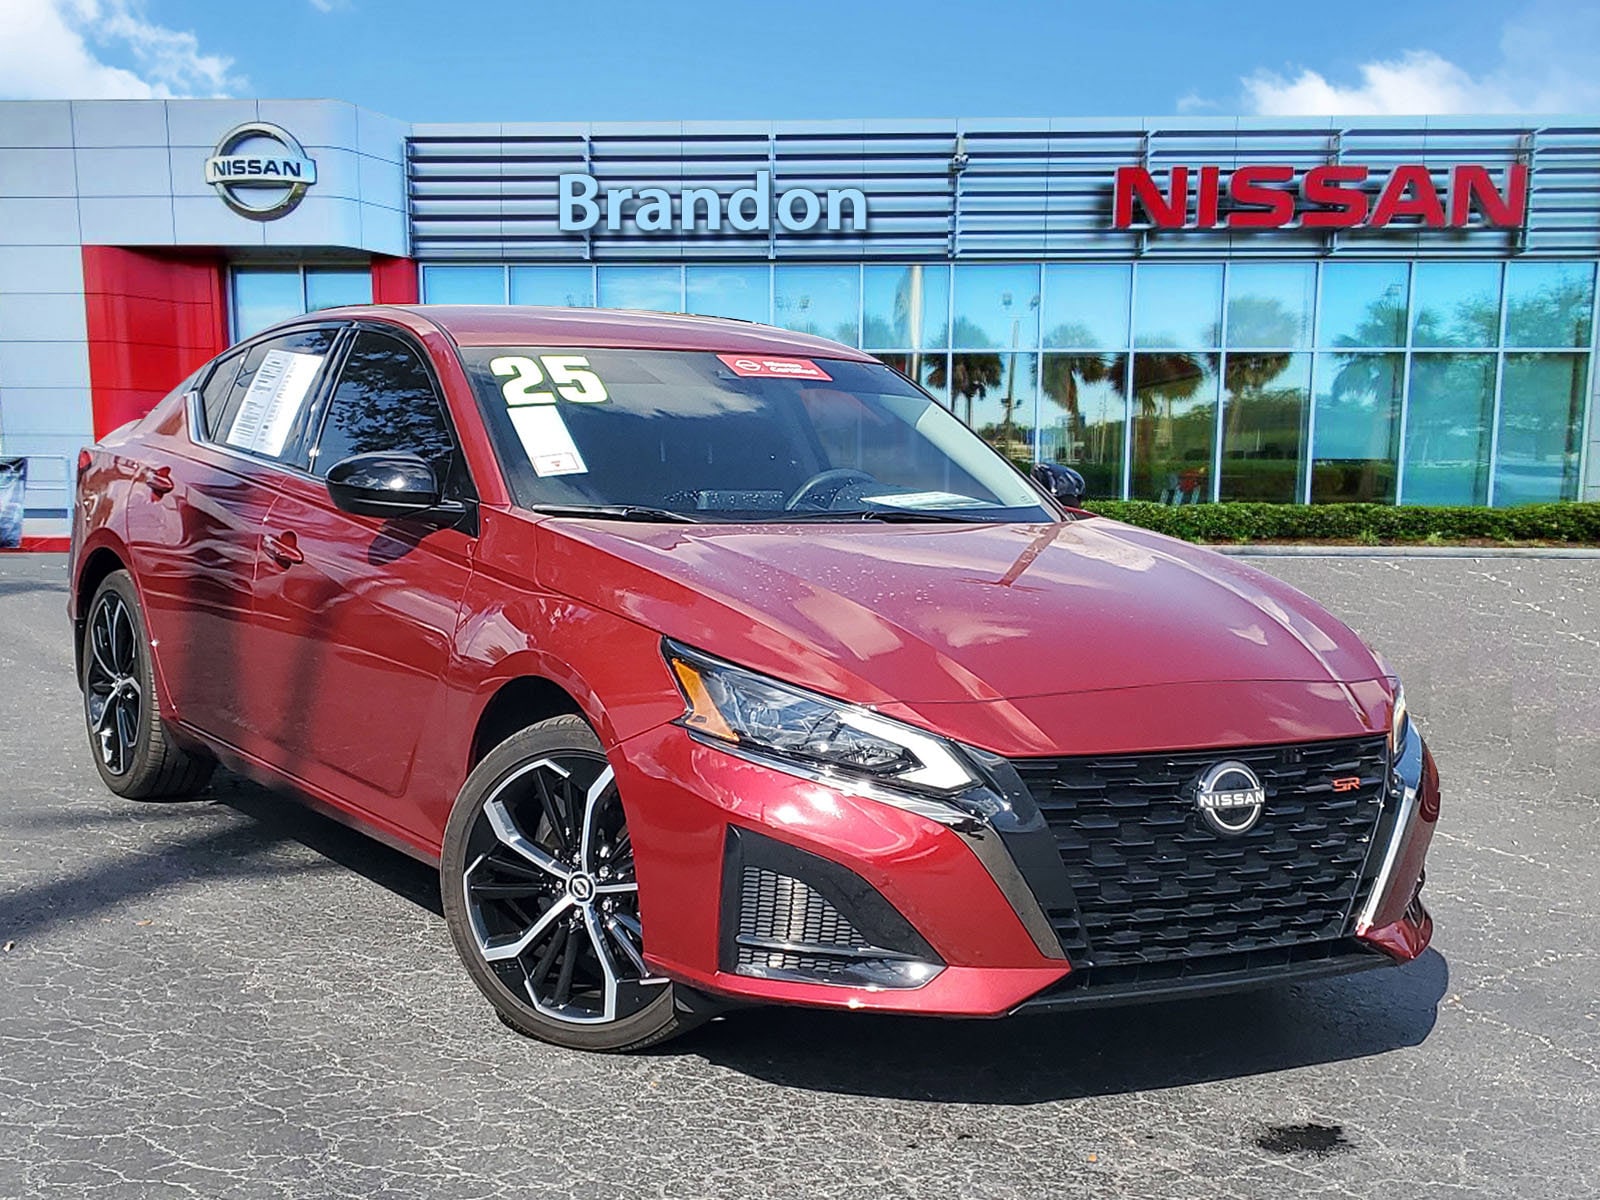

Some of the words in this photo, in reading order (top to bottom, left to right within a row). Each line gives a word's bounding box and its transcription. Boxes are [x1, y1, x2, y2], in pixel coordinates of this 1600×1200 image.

[213, 160, 301, 177] NISSAN
[558, 170, 867, 232] Brandon
[1112, 165, 1528, 229] NISSAN
[489, 355, 609, 405] 25
[1200, 790, 1265, 807] NISSAN
[1332, 777, 1360, 793] SR
